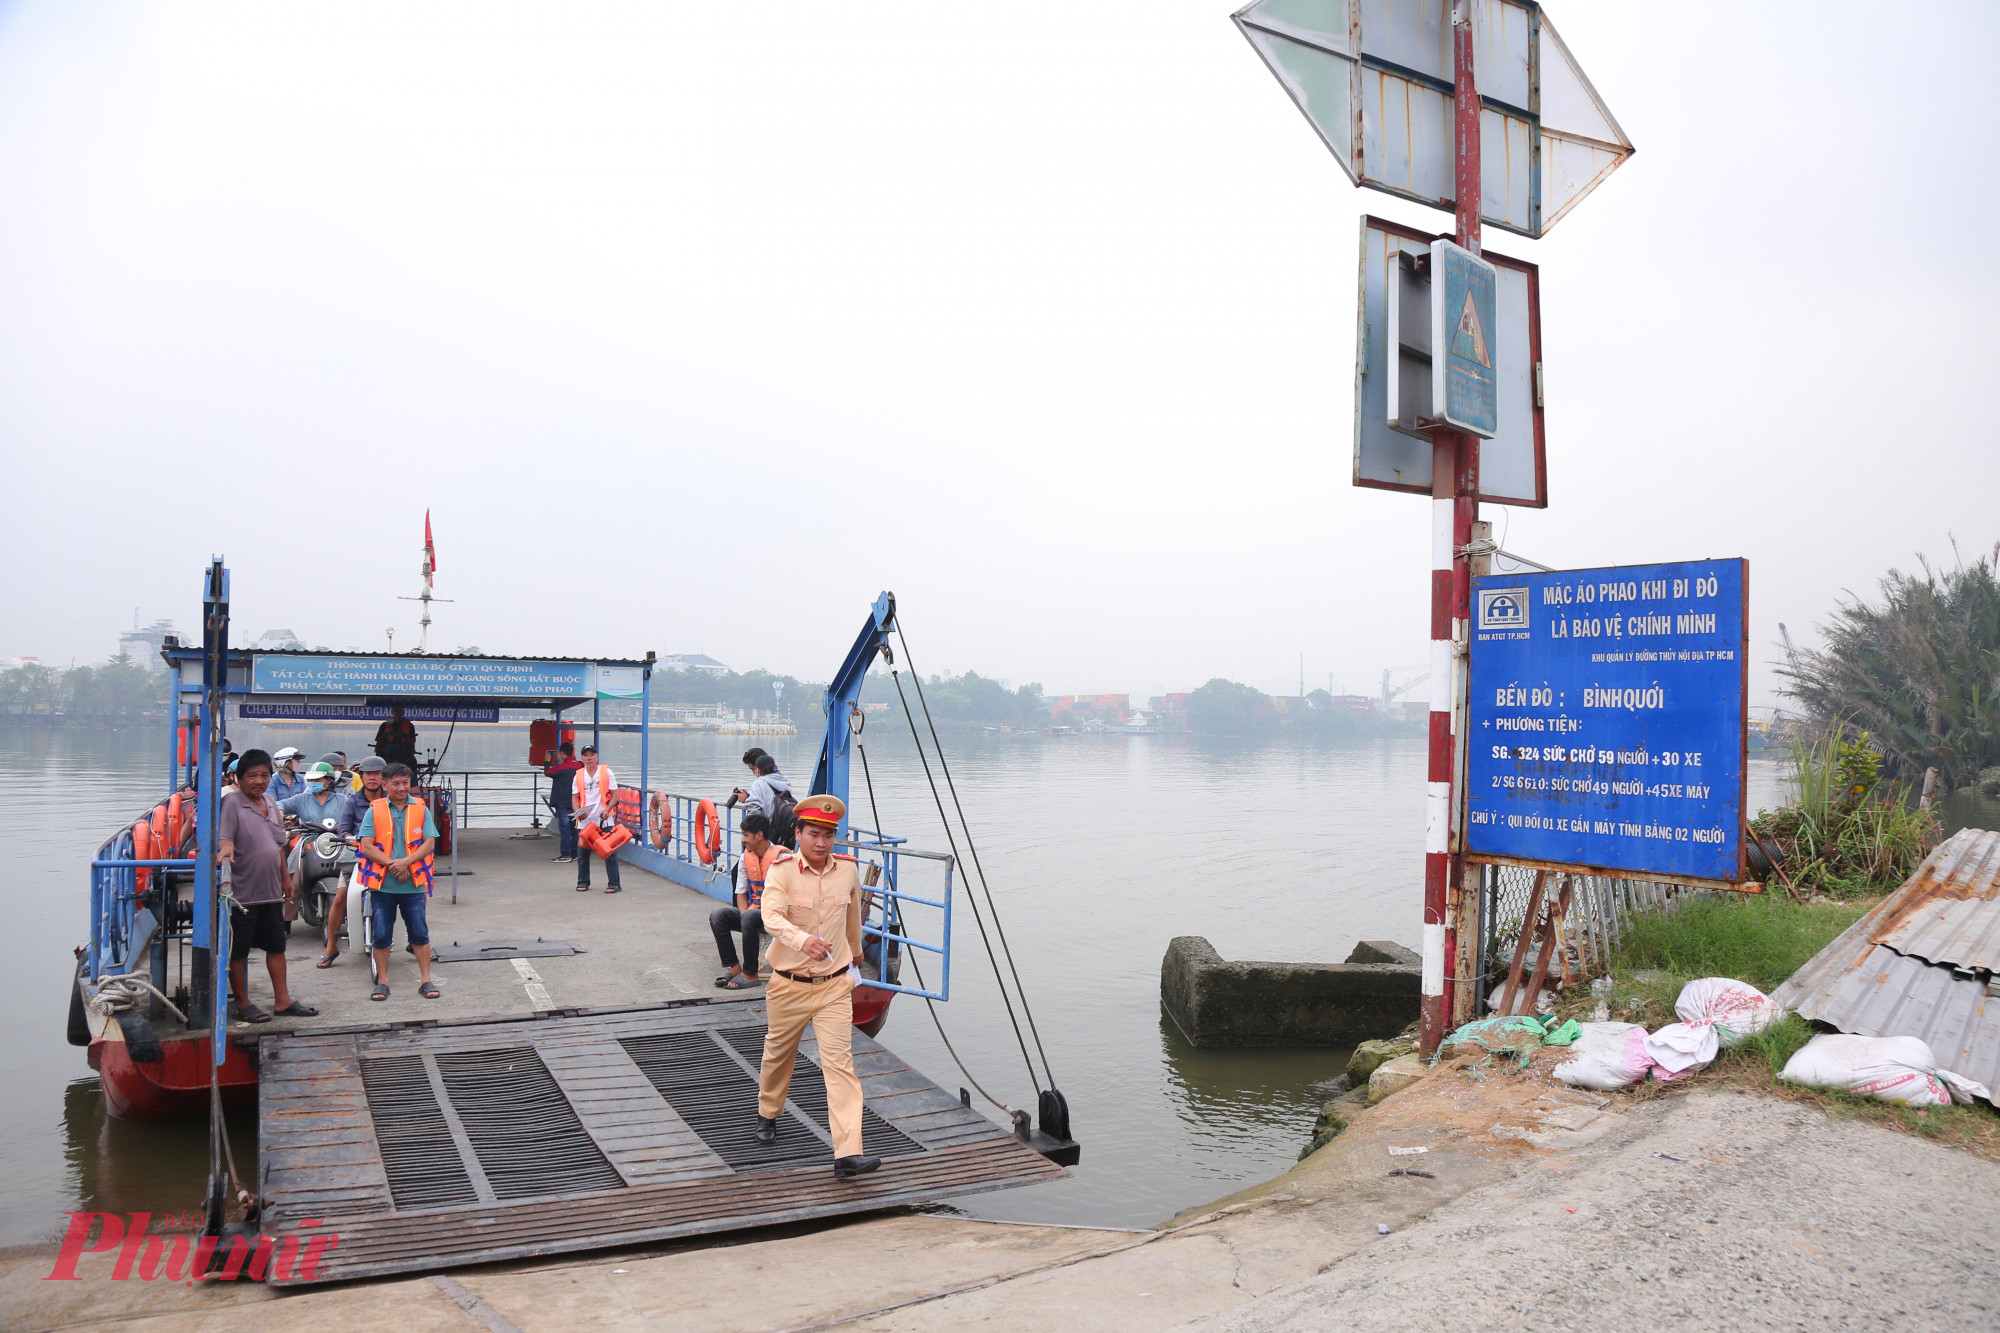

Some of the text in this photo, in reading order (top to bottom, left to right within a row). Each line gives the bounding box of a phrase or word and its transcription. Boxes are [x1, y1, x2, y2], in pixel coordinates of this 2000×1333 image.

[1543, 571, 1718, 608] MẶC ÁO PHAO KHI ĐI ĐÒ
[1551, 609, 1716, 640] LÀ BẢO VỆ CHÍNH MÌNH
[1591, 653, 1605, 663] KHU
[1625, 650, 1634, 662] LÝ
[1635, 649, 1658, 662] ĐƯỜNG
[1705, 650, 1715, 661] TP
[1716, 650, 1734, 661] HCM
[271, 668, 294, 679] TẤT
[344, 671, 377, 680] HÀNH
[380, 671, 419, 681] KHÁCH
[457, 674, 495, 682] NGANG
[497, 674, 527, 683] SÔNG
[552, 674, 582, 684] BUỘC
[326, 661, 367, 669] THÔNG
[370, 662, 386, 670] TƯ
[481, 665, 504, 673] QUY
[507, 665, 533, 674] ĐỊNH
[392, 684, 425, 693] DỤNG
[427, 684, 443, 693] CỤ
[468, 684, 490, 693] CỨU
[493, 685, 519, 693] SINH
[1496, 681, 1527, 707] BẾN
[1531, 681, 1553, 707] ĐÒ
[1496, 717, 1545, 732] PHƯƠNG
[1518, 747, 1540, 761] 324
[1543, 745, 1567, 762] SỨC
[1570, 745, 1596, 763] CHỞ
[1598, 750, 1615, 765] 59
[1617, 747, 1649, 765] NGƯỜI
[1684, 752, 1702, 766] XE
[1551, 776, 1570, 792] SỨC
[1612, 778, 1644, 796] NGƯỜI
[1686, 782, 1711, 800] MÁY
[1471, 809, 1488, 824] CHÚ
[1491, 810, 1497, 825] Ý
[1508, 814, 1523, 829] QUI
[1543, 817, 1554, 830] 01
[1557, 818, 1568, 832] XE
[1594, 818, 1616, 836] MÁY
[1618, 820, 1642, 838] TÍNH
[1675, 828, 1688, 842] 02
[1693, 825, 1726, 844] NGƯỜI
